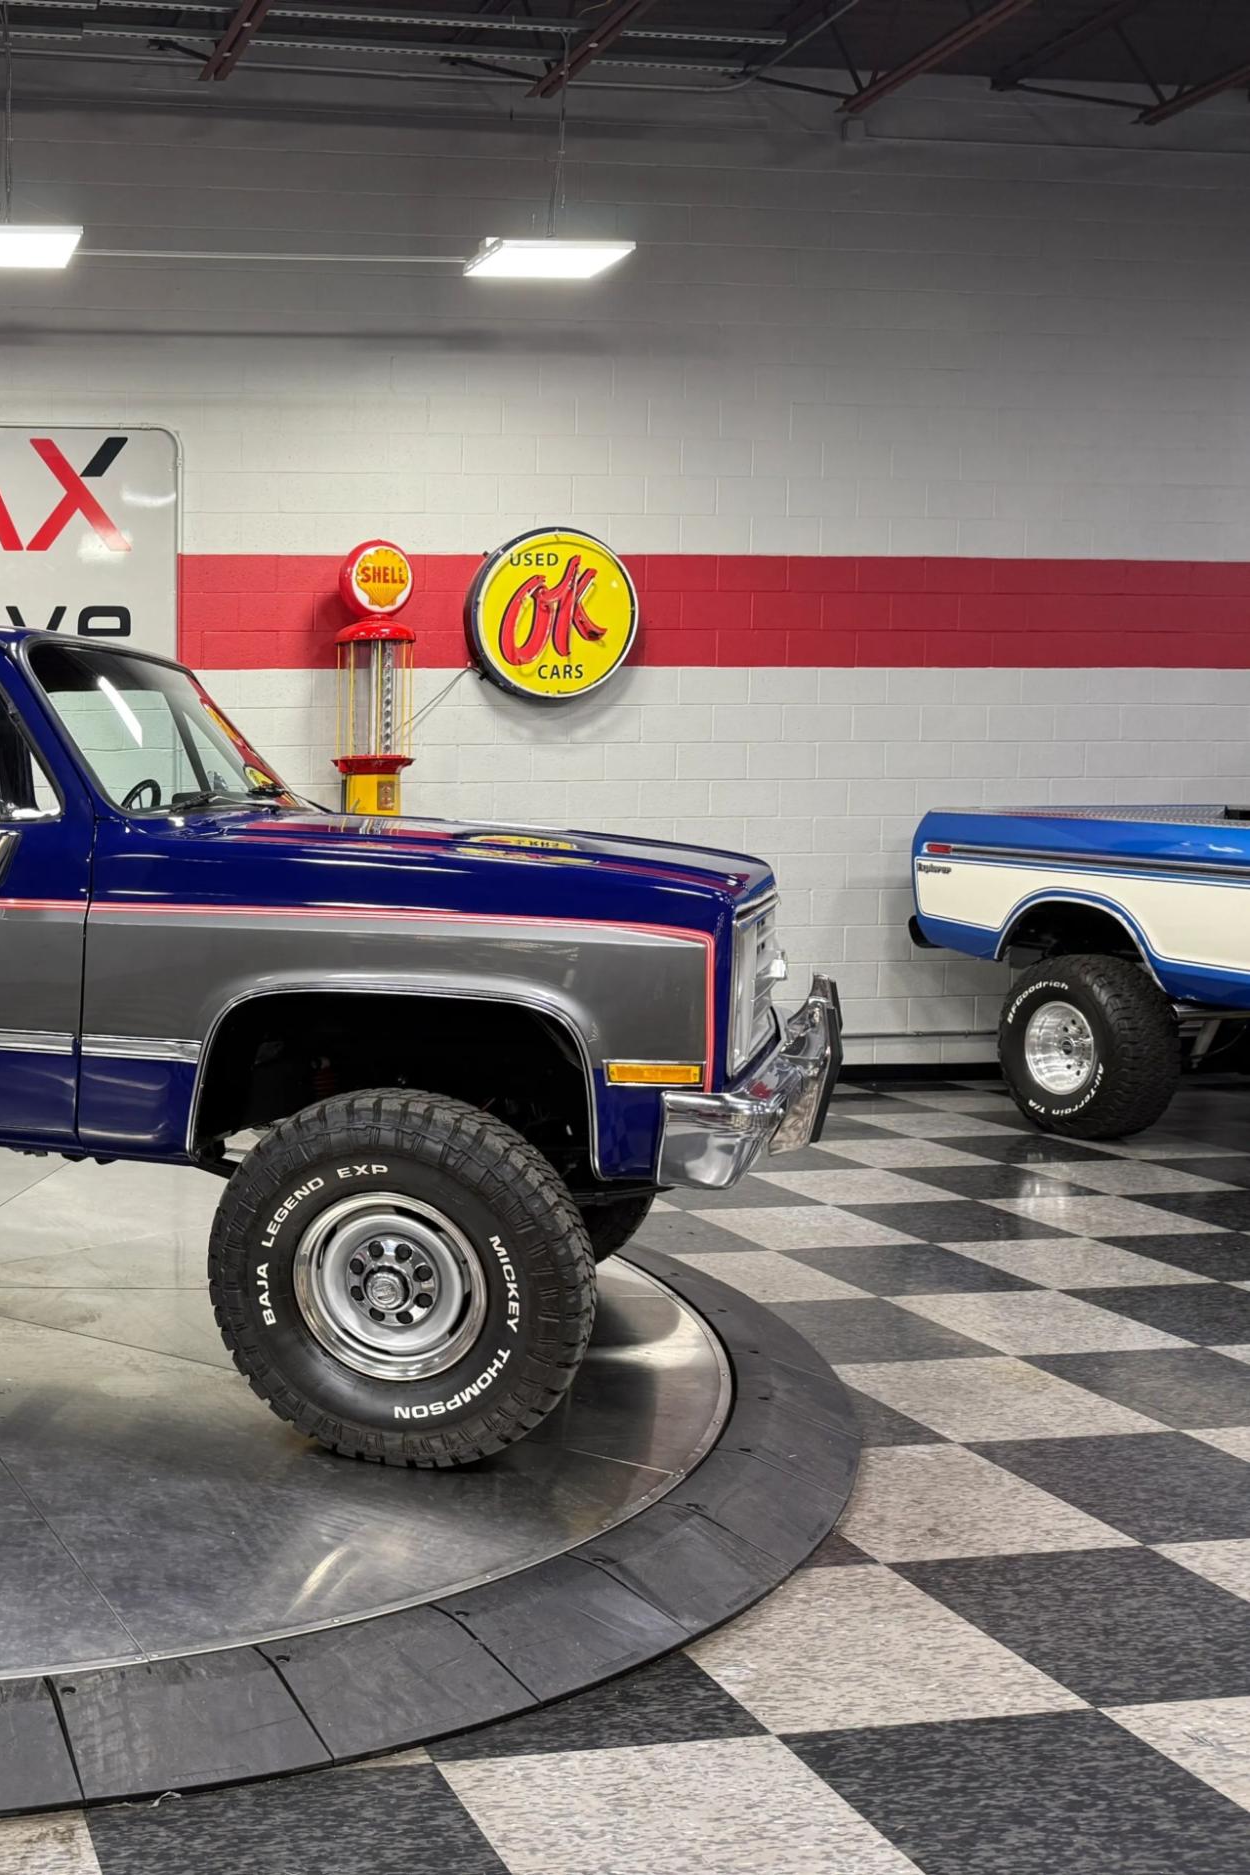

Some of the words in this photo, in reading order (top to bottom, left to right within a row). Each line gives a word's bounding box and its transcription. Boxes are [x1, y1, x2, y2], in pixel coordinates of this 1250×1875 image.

[359, 565, 406, 585] SHELL
[509, 552, 559, 567] USED
[498, 554, 608, 667] OK
[537, 664, 584, 680] CARS
[1006, 979, 1069, 1025] BFGoodrich
[1028, 1098, 1046, 1115] T/A
[335, 1163, 389, 1179] EXP
[261, 1176, 325, 1248] LEGEND
[256, 1261, 277, 1327] BAJA
[488, 1234, 521, 1334] MICKEY
[393, 1347, 512, 1420] THOMPSON
